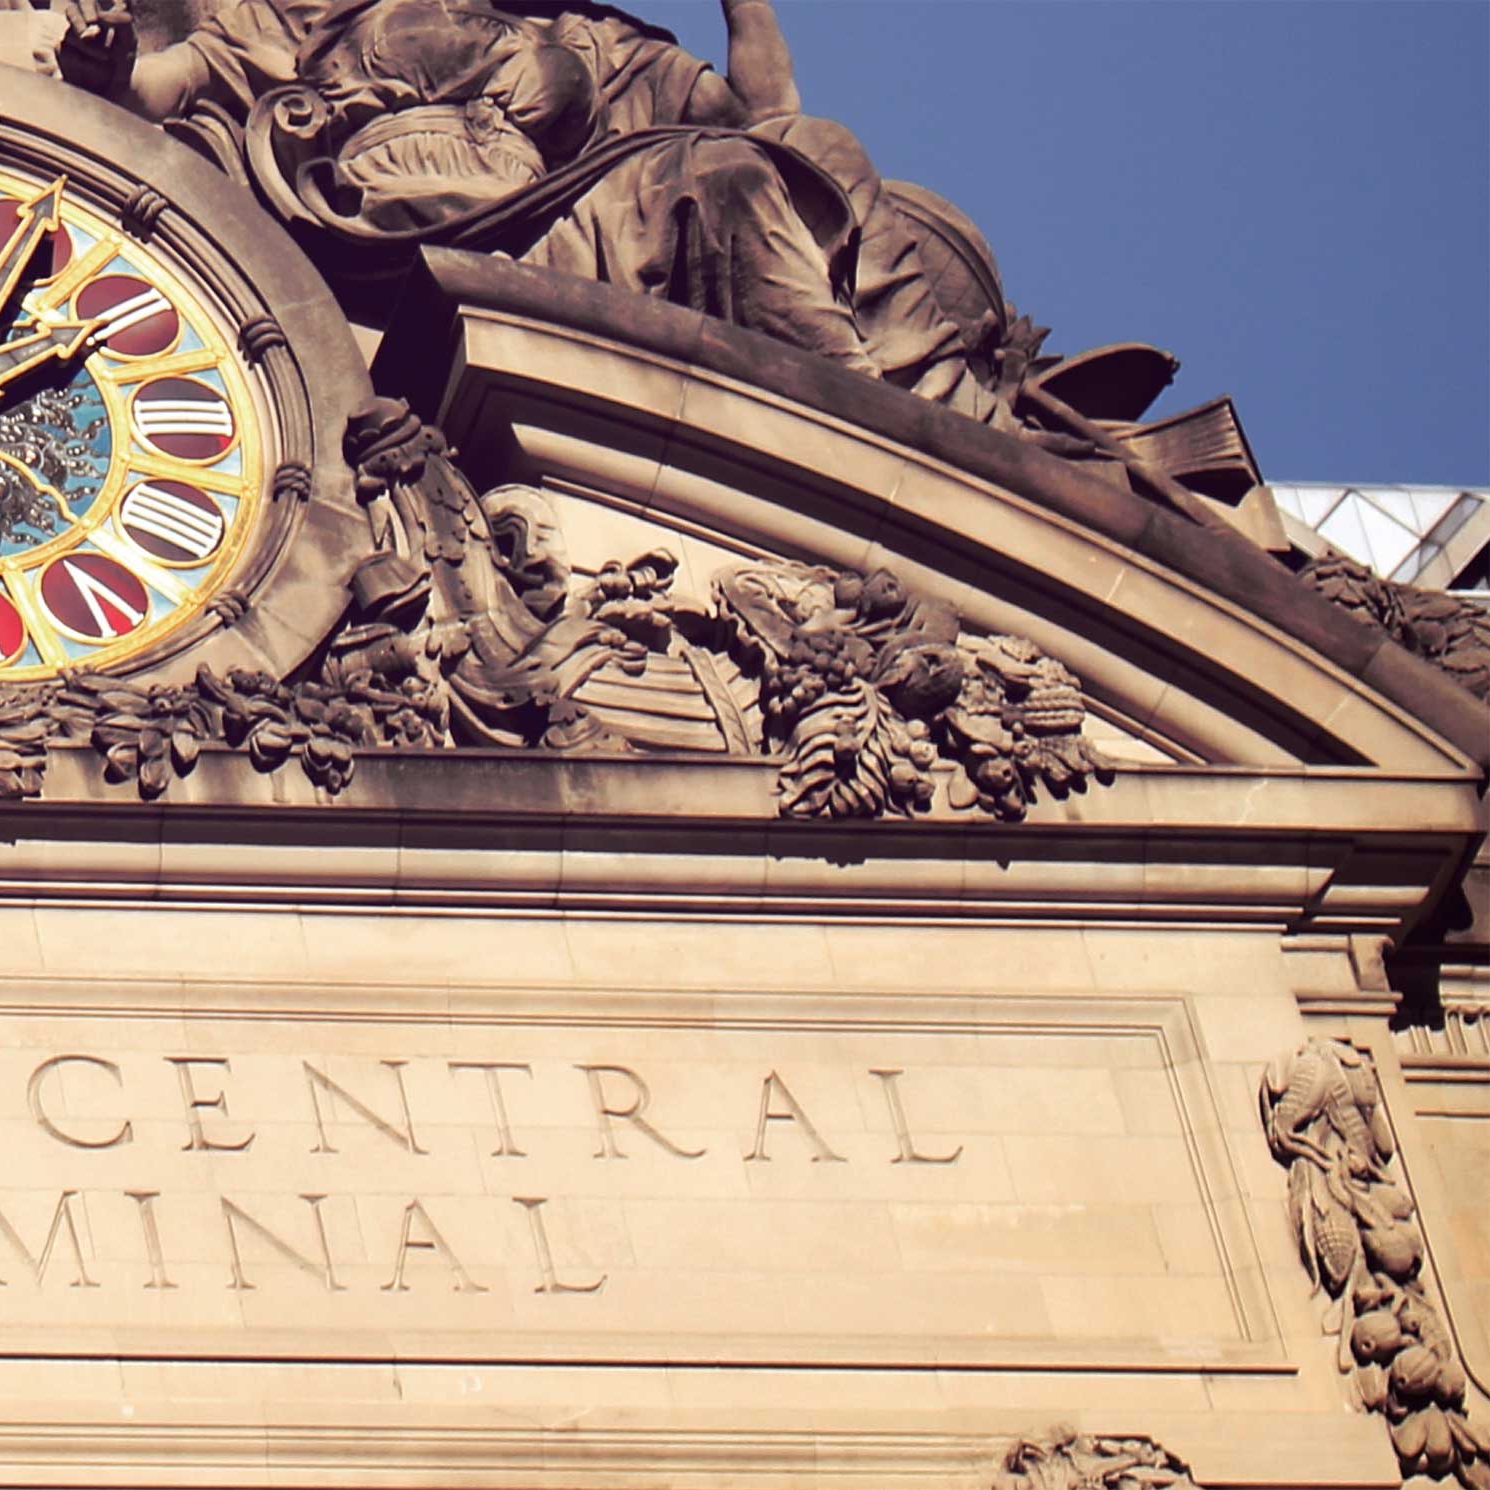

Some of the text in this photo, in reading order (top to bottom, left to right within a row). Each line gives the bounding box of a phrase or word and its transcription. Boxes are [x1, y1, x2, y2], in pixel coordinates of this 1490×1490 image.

[133, 399, 232, 436] III
[121, 483, 224, 558] IIII
[62, 559, 146, 638] V
[26, 1054, 964, 1165] CENTRAL
